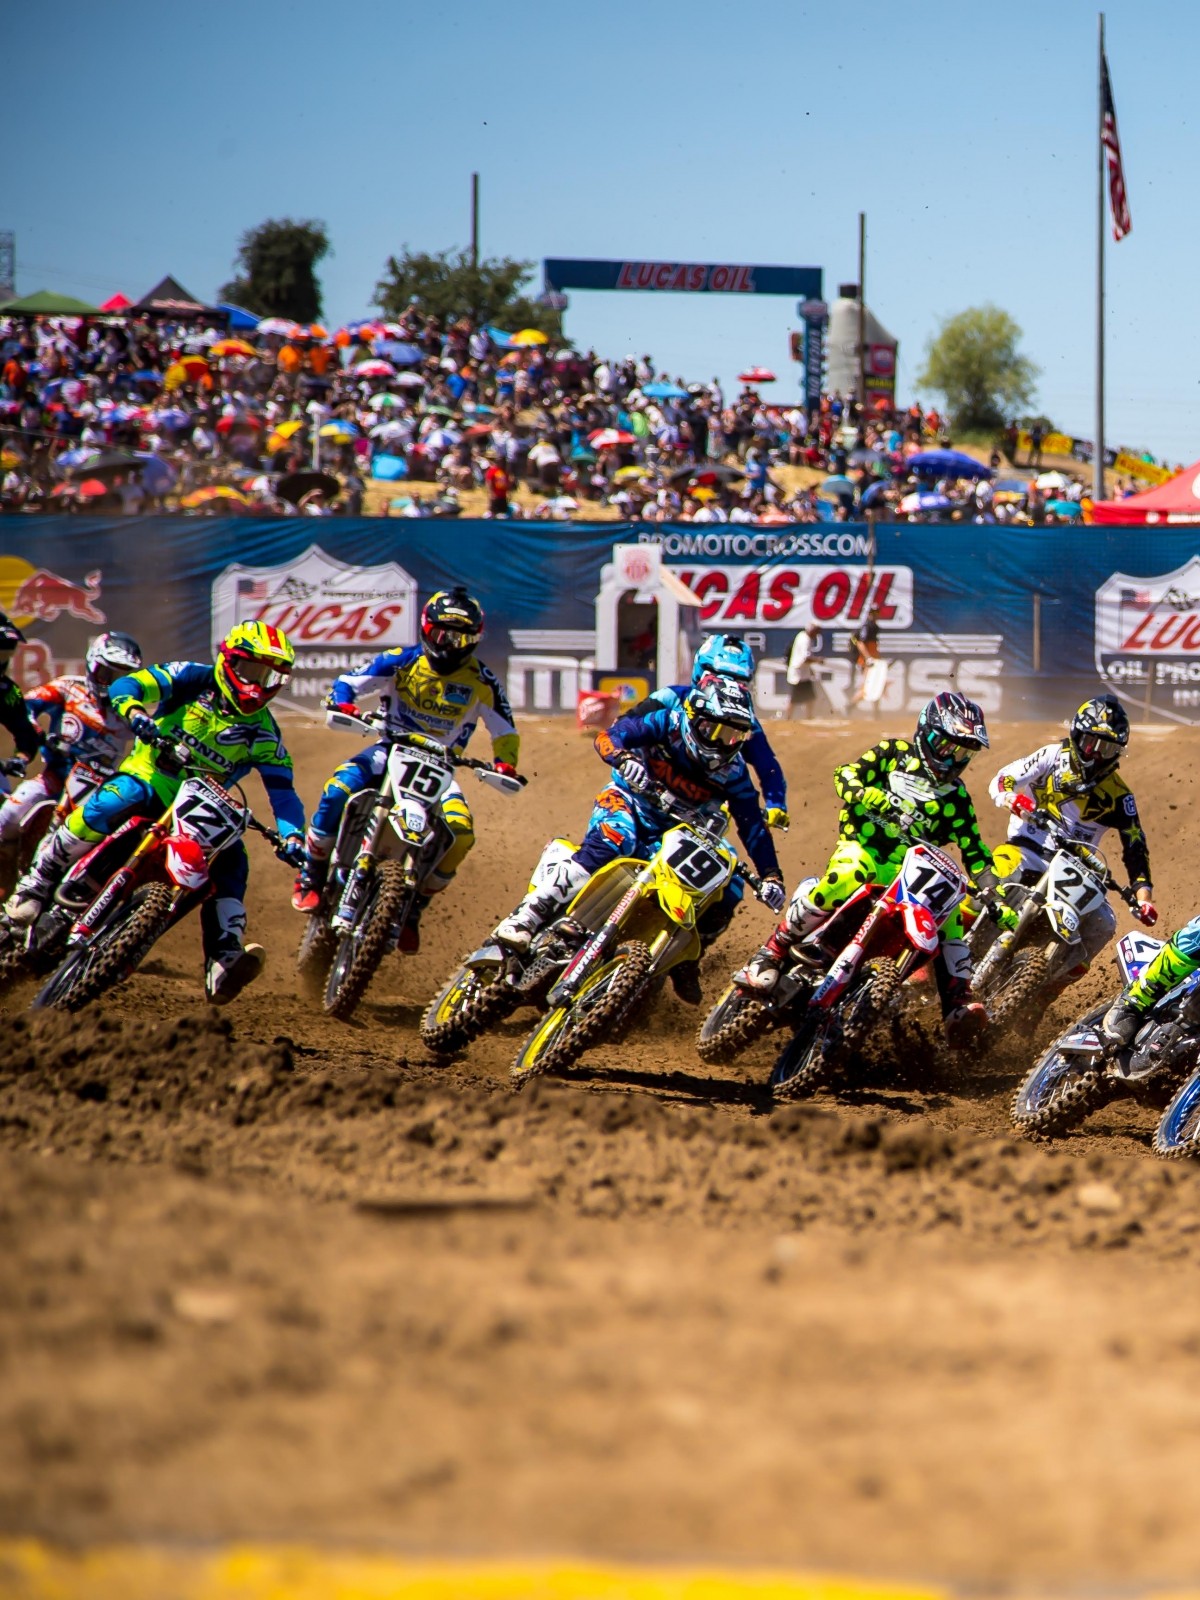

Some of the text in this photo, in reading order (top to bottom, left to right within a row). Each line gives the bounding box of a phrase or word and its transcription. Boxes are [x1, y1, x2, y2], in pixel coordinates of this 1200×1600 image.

[617, 263, 755, 292] LUCAS OIL
[811, 571, 898, 621] OIL
[1107, 660, 1149, 681] OIL
[170, 725, 236, 773] HONDA
[200, 787, 223, 809] LUCAS
[398, 759, 445, 798] 15
[175, 795, 238, 849] 121
[665, 837, 728, 889] 19
[930, 858, 949, 875] LUCAS
[906, 864, 956, 914] 14
[1054, 867, 1099, 912] 21
[1134, 939, 1161, 954] 2
